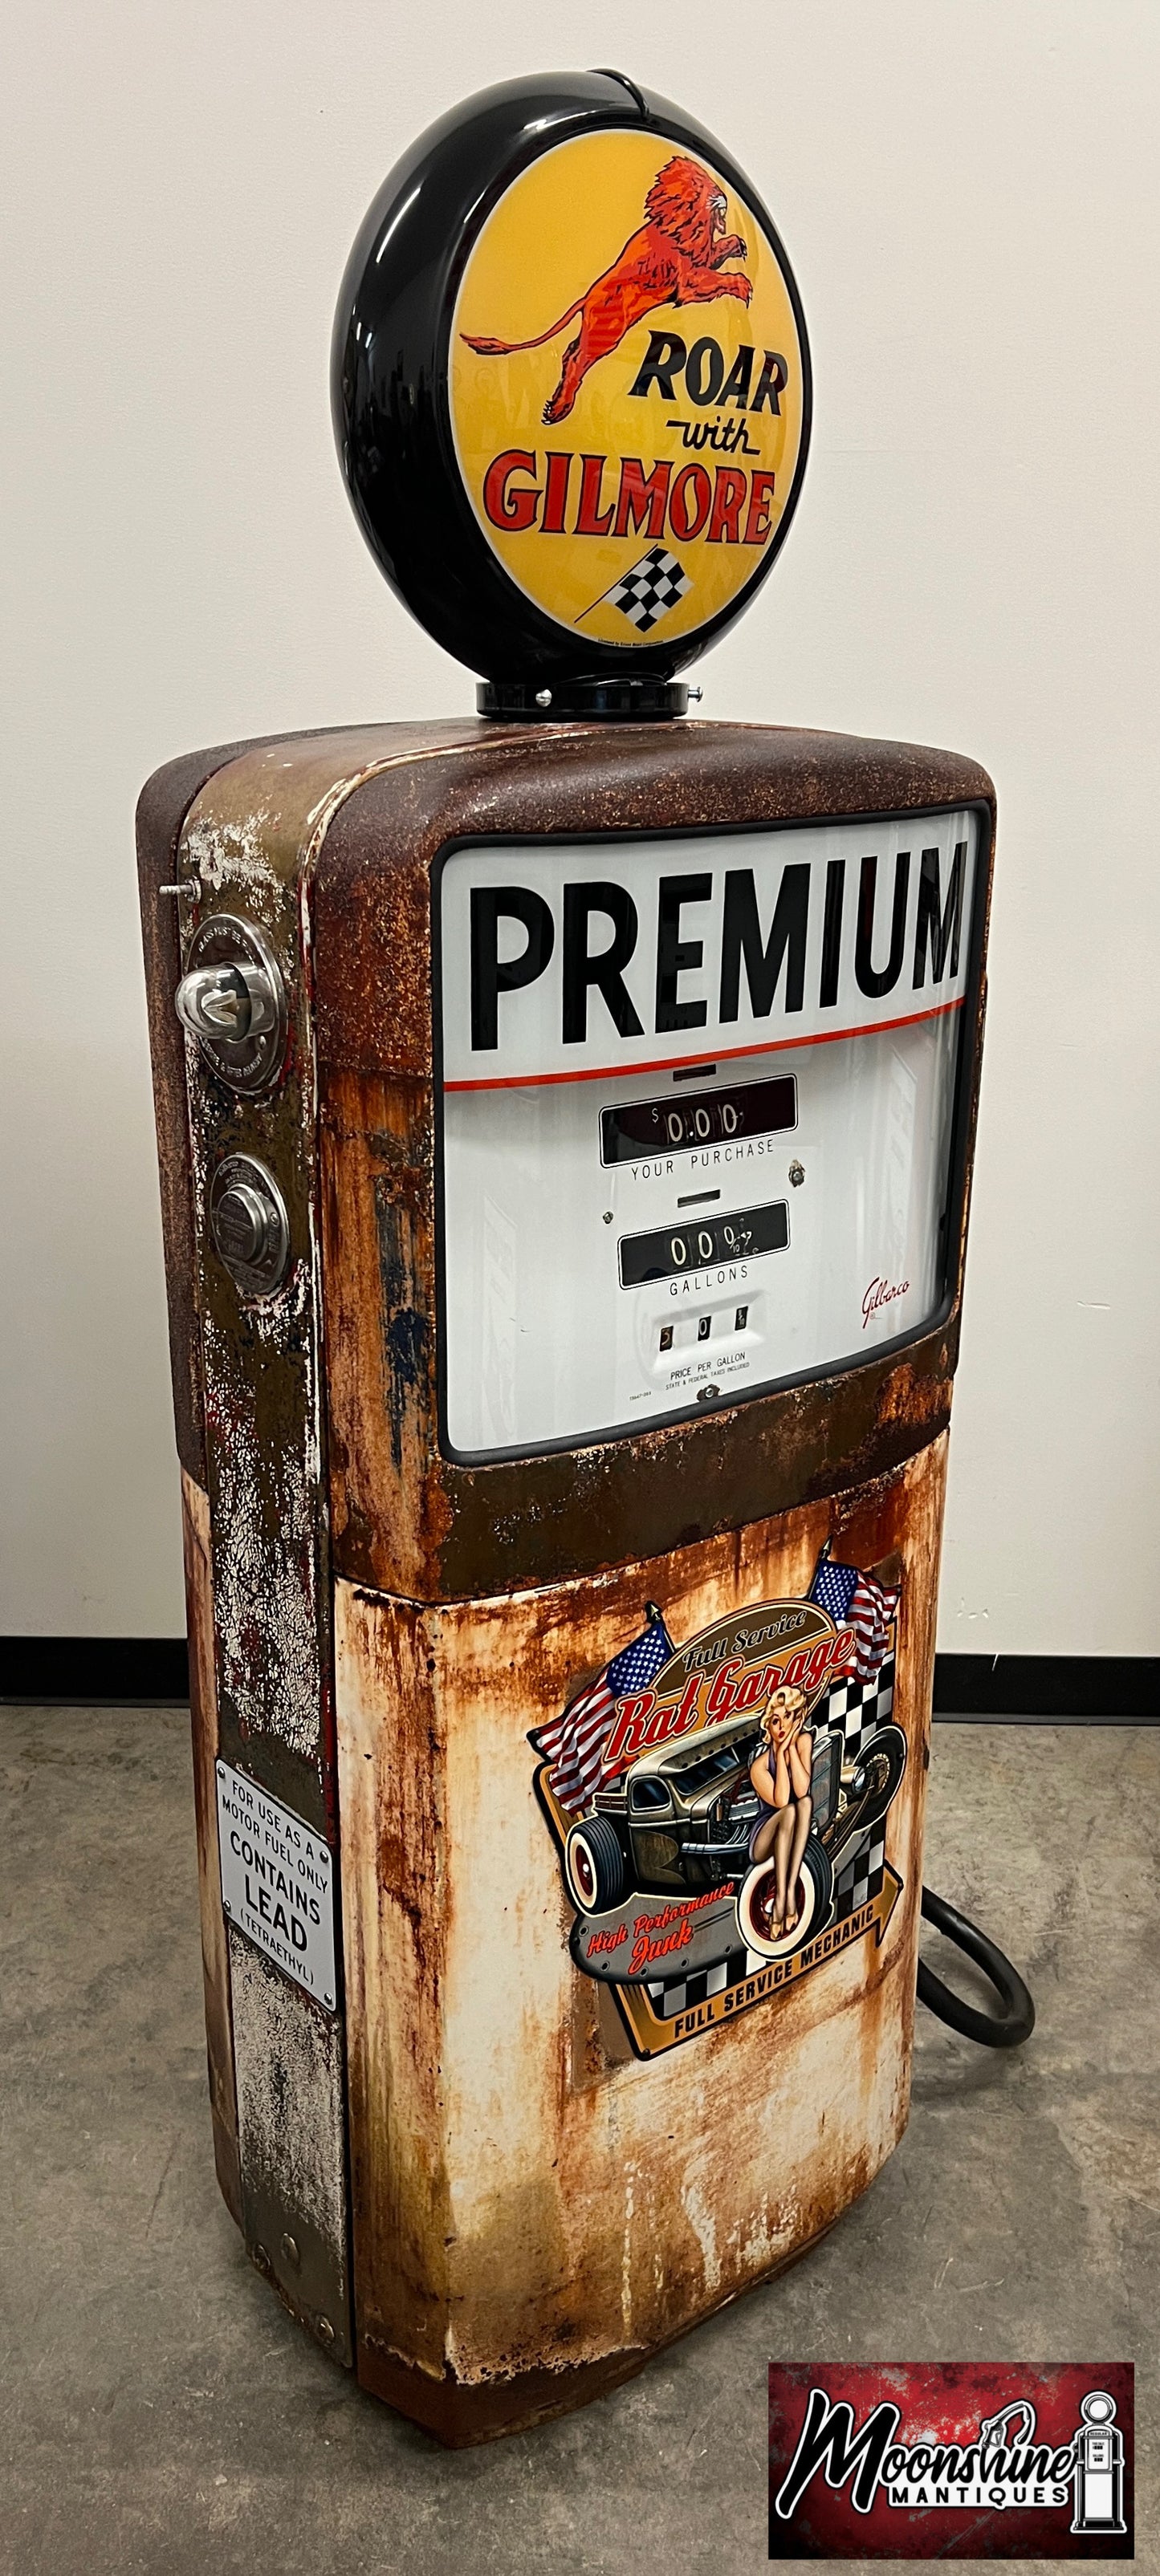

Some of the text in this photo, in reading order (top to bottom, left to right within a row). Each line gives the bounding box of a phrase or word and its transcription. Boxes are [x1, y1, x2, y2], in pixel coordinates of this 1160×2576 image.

[628, 330, 789, 417] ROAR
[666, 418, 762, 457] with
[482, 449, 776, 546] GILMORE
[469, 839, 968, 1052] PREMIUM
[631, 1139, 774, 1181] YOUR PURCHASE
[670, 1265, 748, 1296] GALLONS
[861, 1276, 910, 1330] Gilbarco
[665, 1380, 681, 1392] STATE
[688, 1373, 708, 1383] FEDERAL
[670, 1351, 747, 1381] PRICE PER GALLON
[682, 1609, 808, 1672] Full Service
[604, 1627, 857, 1763] Rat Garage
[222, 1794, 328, 1894] MOTOR FUEL ONLY
[232, 1779, 314, 1860] FOR USE AS A
[230, 1830, 320, 1925] CONTAINS
[245, 1874, 307, 1952] LEAD
[240, 1908, 314, 1985] (TETRAETHYL)
[586, 1881, 735, 1958] High Performance
[628, 1918, 695, 1976] Junk
[674, 1904, 874, 2038] FULL SERVICE MECHANIC
